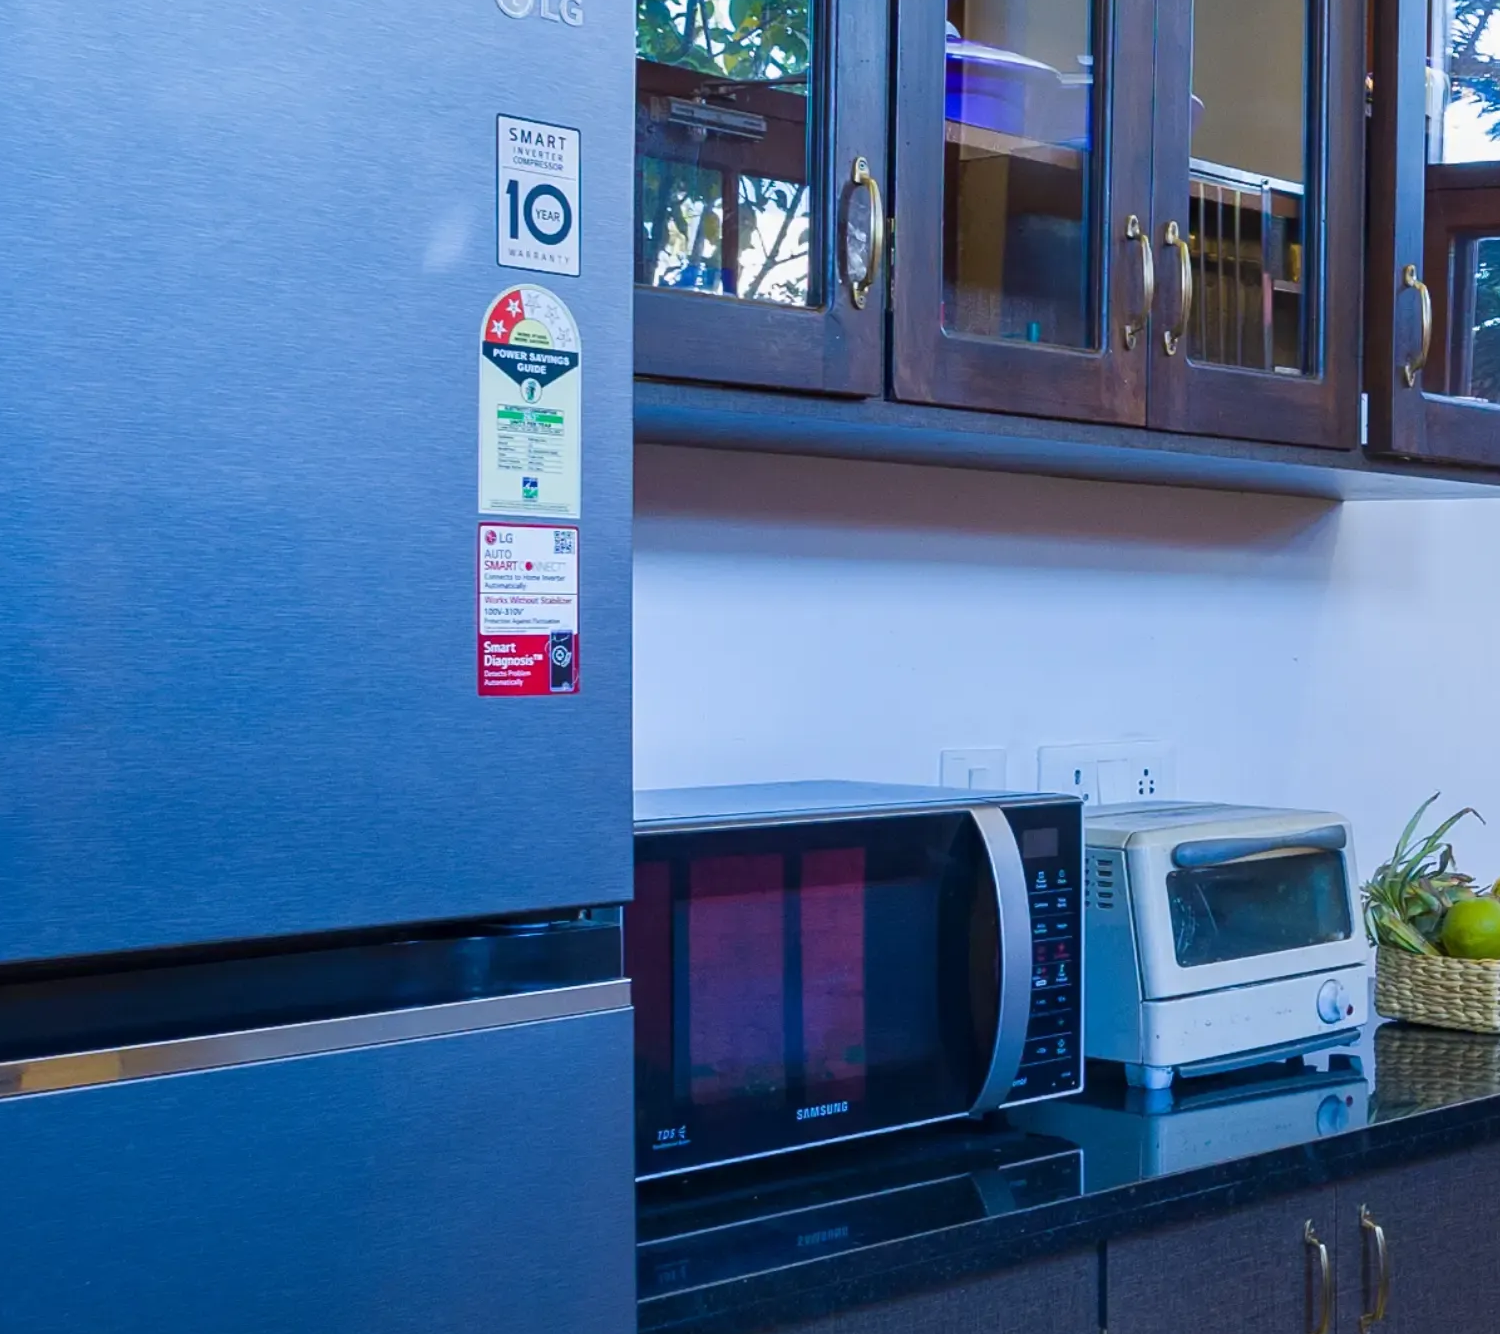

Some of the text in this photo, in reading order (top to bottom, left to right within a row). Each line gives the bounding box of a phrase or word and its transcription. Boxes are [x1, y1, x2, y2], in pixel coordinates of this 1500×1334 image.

[508, 127, 567, 150] SMART
[513, 147, 564, 162] INVERTER
[513, 155, 564, 171] COMPRESSOR
[506, 179, 572, 245] 10
[536, 208, 561, 222] YEAR
[508, 248, 570, 265] WARRANTY
[493, 348, 570, 366] POWER SAVINGS
[516, 363, 547, 375] GUIDE
[499, 533, 513, 544] LG
[484, 549, 512, 559] AUTO
[483, 641, 517, 653] Smart
[796, 1101, 848, 1120] SAMSUNG
